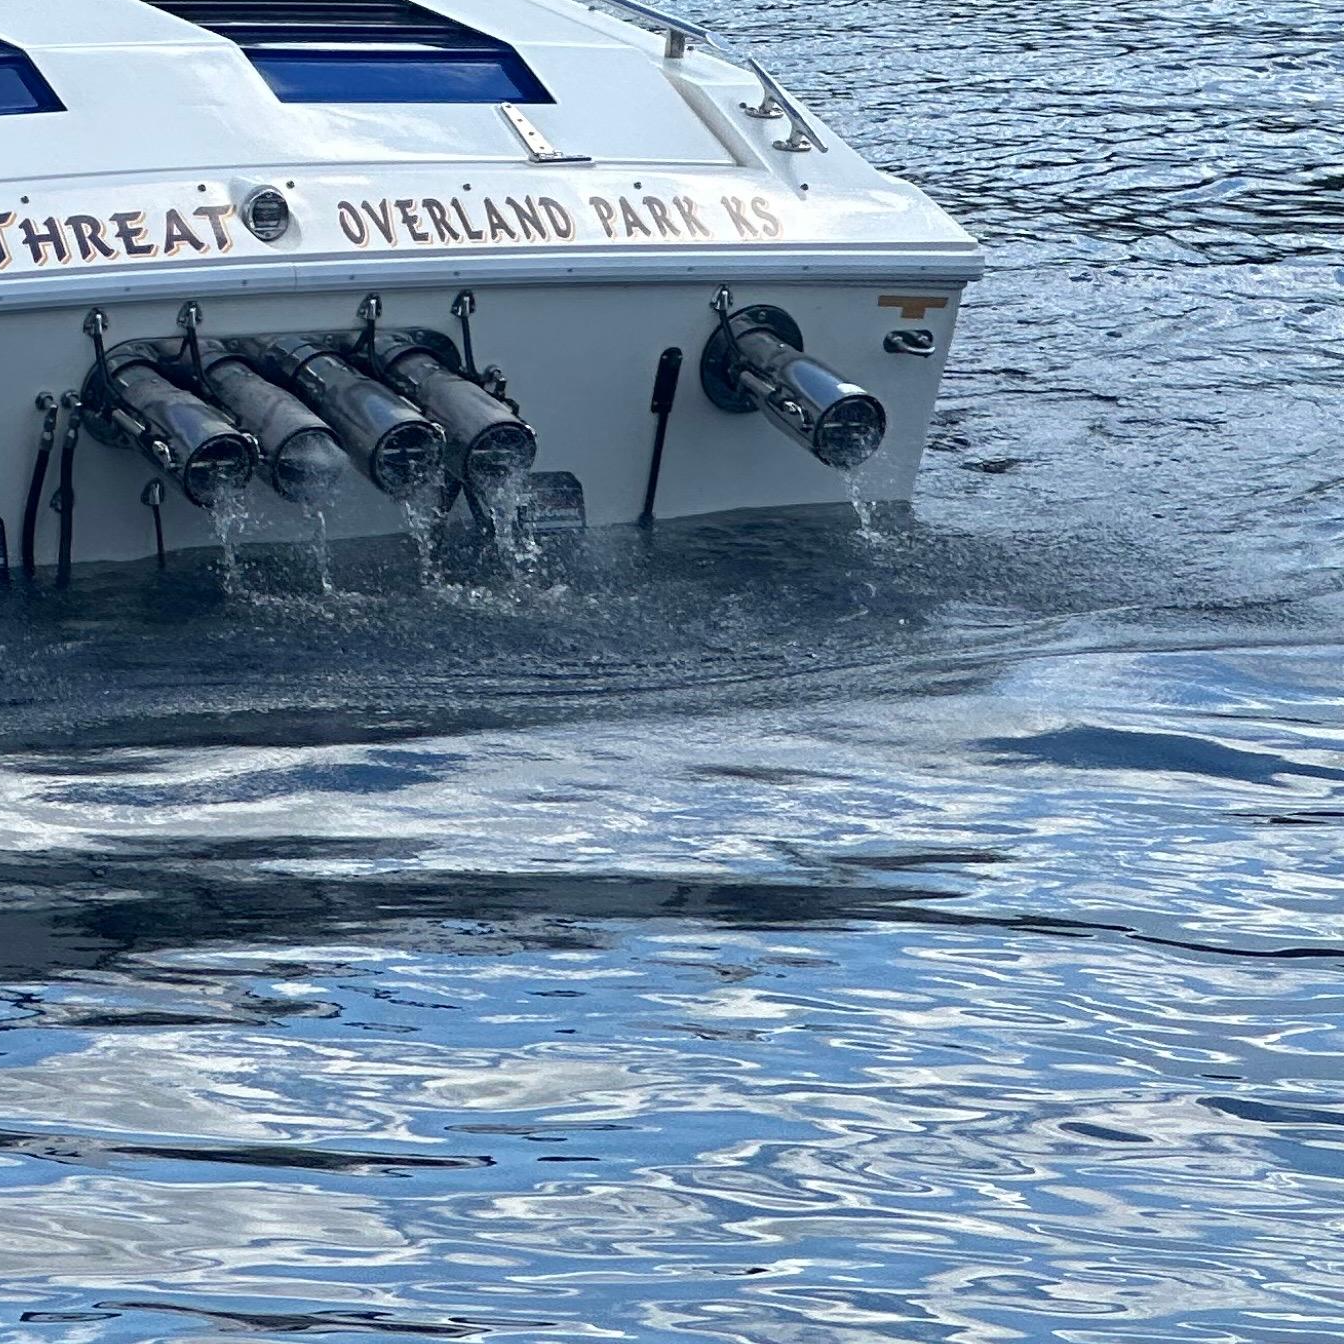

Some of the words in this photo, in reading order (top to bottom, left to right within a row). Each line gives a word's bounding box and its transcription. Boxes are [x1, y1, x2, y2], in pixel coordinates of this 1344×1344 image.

[337, 194, 576, 247] OVERLAND
[589, 195, 714, 239] PARK
[720, 195, 784, 238] KS
